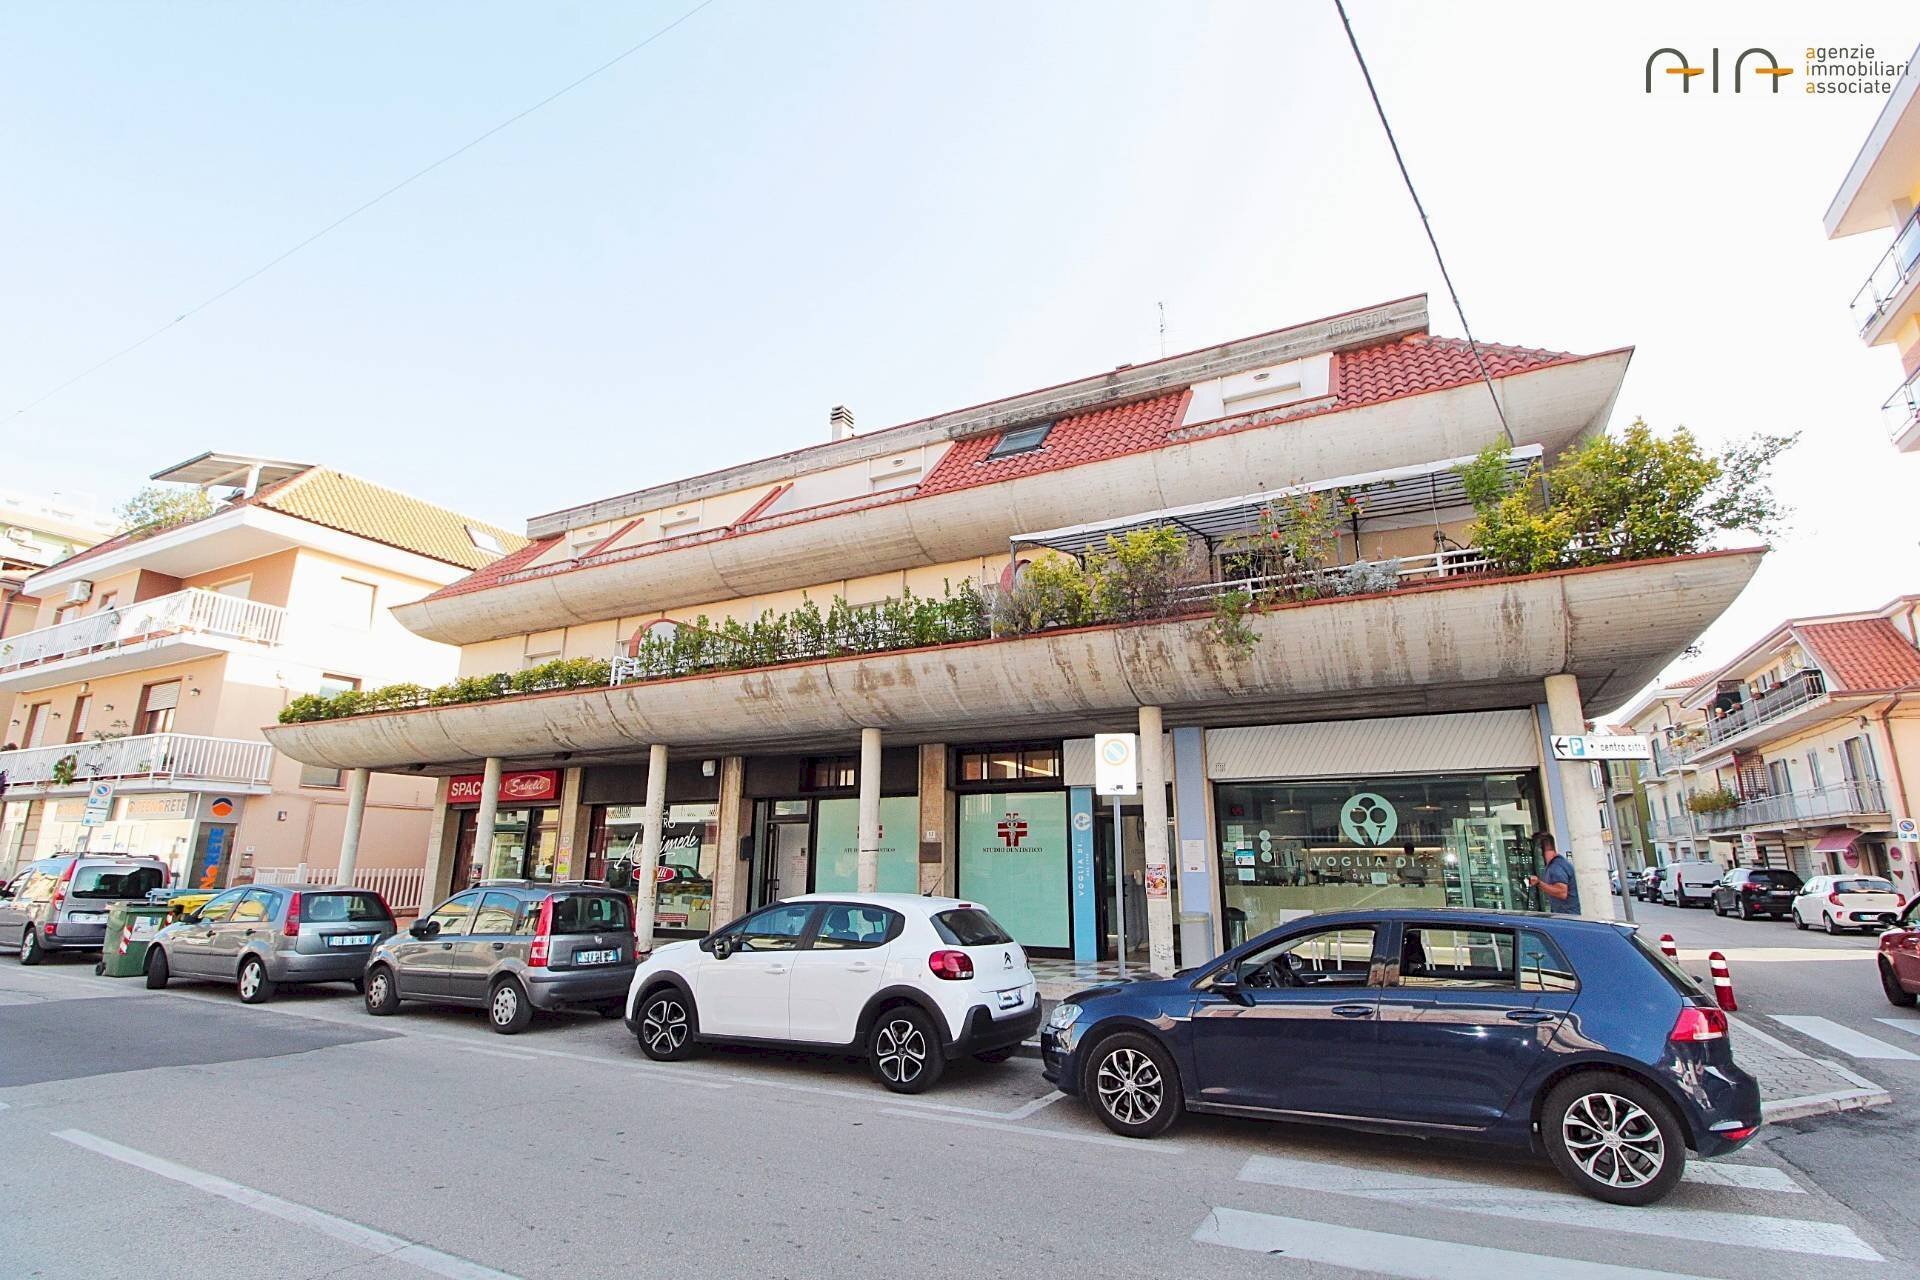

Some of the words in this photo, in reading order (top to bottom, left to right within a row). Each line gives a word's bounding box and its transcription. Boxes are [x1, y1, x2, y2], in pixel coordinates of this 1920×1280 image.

[1600, 741, 1626, 752] centro
[451, 781, 501, 797] SPAC
[510, 779, 545, 793] Sabelli
[1313, 856, 1384, 868] VOGLIA
[1077, 859, 1085, 896] VOGLIA
